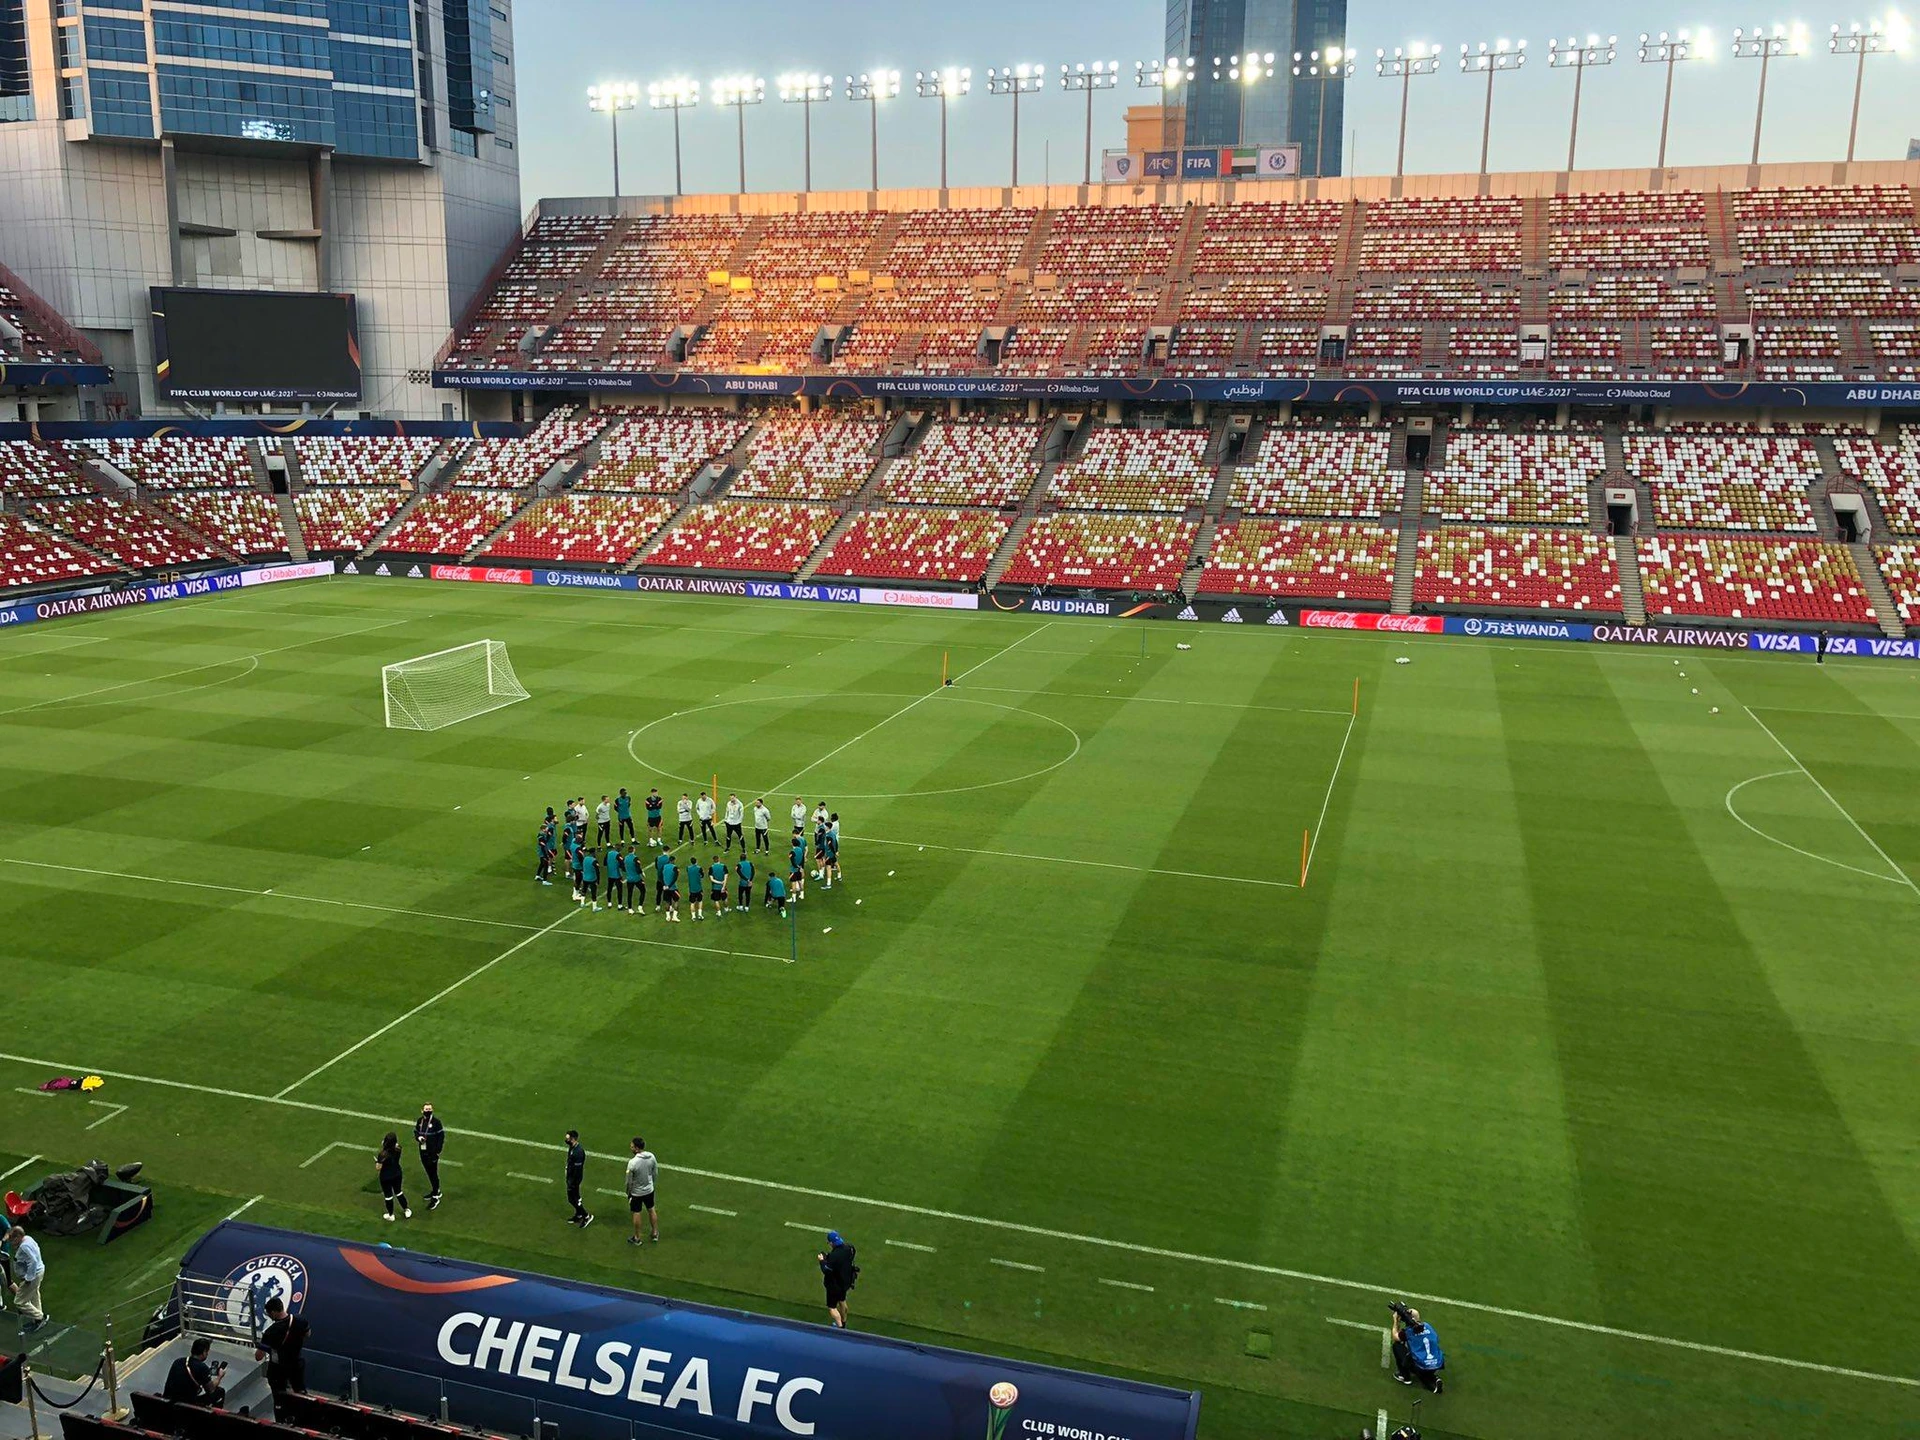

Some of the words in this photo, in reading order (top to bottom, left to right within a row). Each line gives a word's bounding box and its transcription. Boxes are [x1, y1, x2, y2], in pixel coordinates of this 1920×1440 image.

[1147, 157, 1172, 170] AFC
[1186, 158, 1212, 169] FIFA
[444, 376, 460, 384] FIFA
[462, 376, 481, 384] CLUB
[482, 377, 511, 385] WORLD
[725, 381, 745, 390] ABU
[747, 381, 778, 391] DHABI
[877, 382, 896, 391] FIFA
[897, 382, 920, 391] CLUB
[922, 383, 956, 392] WORLD
[957, 384, 976, 392] CUP
[1059, 385, 1081, 393] Alibaba
[1082, 385, 1099, 393] Cloud
[1223, 381, 1264, 398] أبوظبي
[1397, 386, 1420, 396] FIFA
[1422, 387, 1451, 396] CLUB
[1453, 387, 1494, 396] WORLD
[1496, 388, 1519, 397] CUP
[1621, 389, 1648, 398] Alibaba
[1649, 389, 1671, 398] Cloud
[1846, 389, 1877, 400] ABU
[273, 568, 296, 580] Alibaba
[297, 565, 316, 577] Cloud
[182, 578, 211, 595] VISA
[214, 573, 241, 590] VISA
[583, 575, 622, 588] WANDA
[638, 576, 684, 593] QATAR
[686, 579, 746, 596] AIRWAYS
[150, 583, 179, 600] VISA
[750, 583, 782, 598] VISA
[787, 585, 820, 600] VISA
[825, 587, 858, 602] VISA
[36, 599, 86, 619] QATAR
[90, 588, 147, 610] AIRWAYS
[900, 592, 929, 604] Alibaba
[930, 594, 953, 606] Cloud
[1031, 599, 1062, 612] ABU
[1065, 601, 1110, 615] DHABI
[1484, 621, 1515, 635] 万达
[1515, 622, 1570, 638] WANDA
[1593, 624, 1659, 644] QATAR
[1663, 628, 1749, 647] AIRWAYS
[1754, 632, 1801, 651] VISA
[1866, 639, 1915, 657] VISA
[246, 1256, 303, 1281] CHELSEA
[436, 1311, 713, 1416] CHELSEA
[736, 1366, 825, 1435] FC
[1022, 1419, 1055, 1435] CLUB
